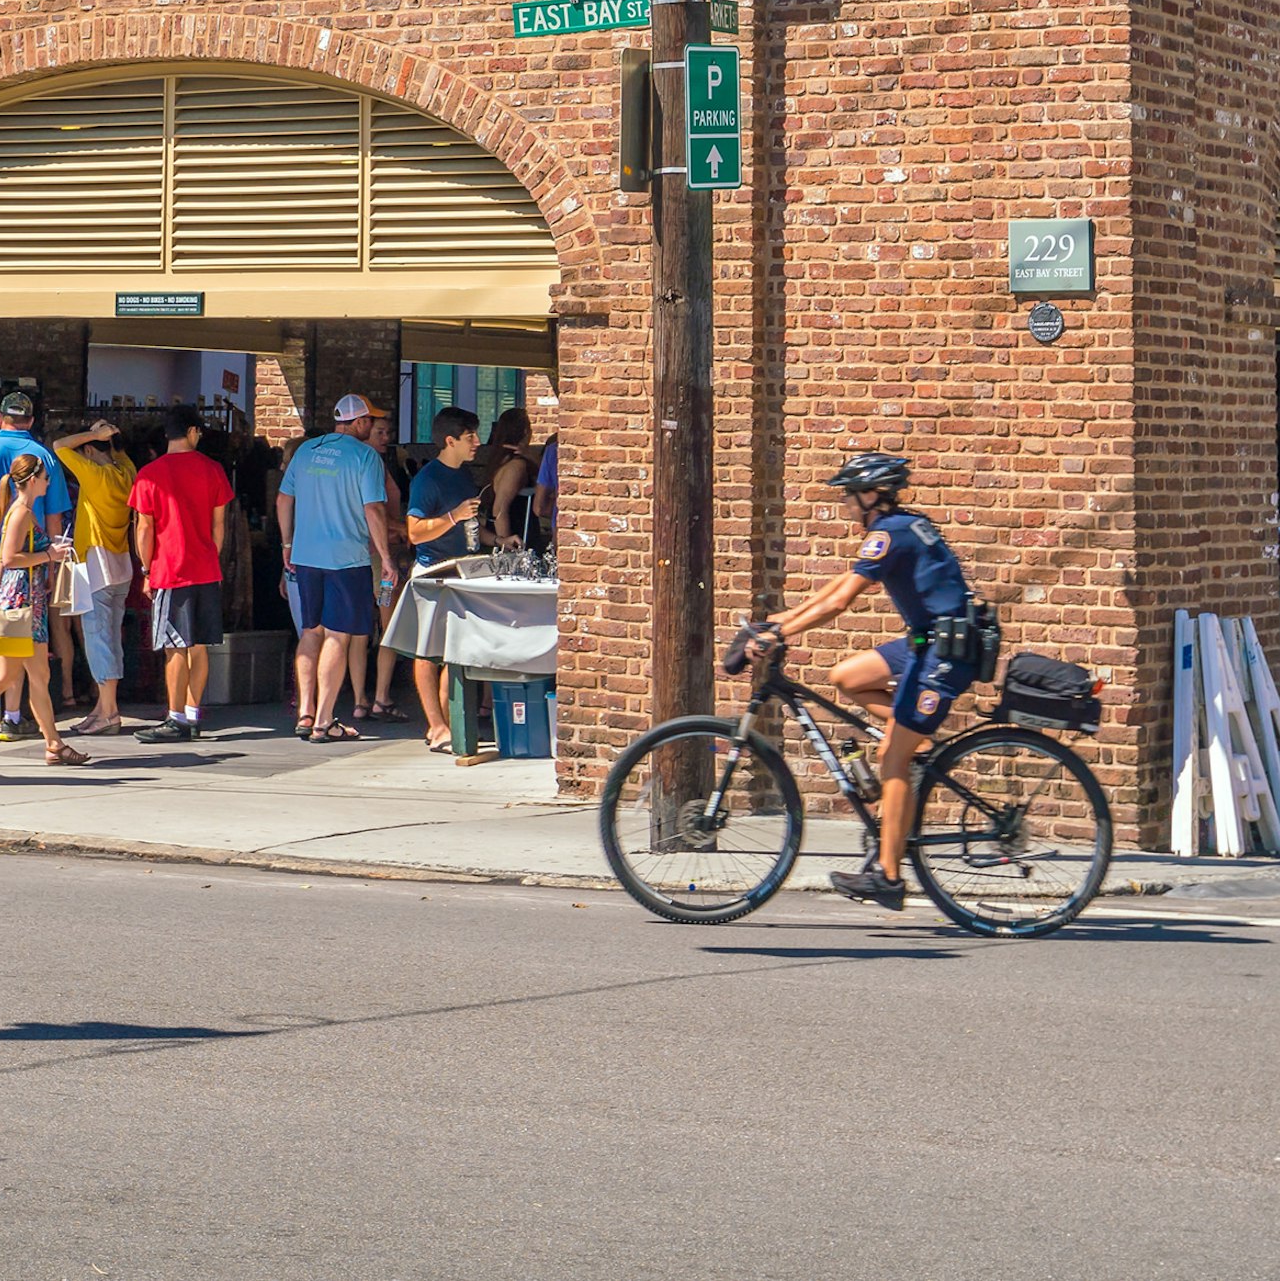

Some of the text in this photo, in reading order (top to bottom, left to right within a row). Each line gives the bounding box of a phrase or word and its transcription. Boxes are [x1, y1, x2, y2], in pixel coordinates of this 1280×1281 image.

[518, 3, 572, 33] EAST
[627, 0, 643, 18] ST
[710, 1, 732, 29] ARKET
[707, 64, 723, 100] P
[693, 109, 736, 127] PARKING
[1023, 233, 1075, 264] 229
[1014, 266, 1085, 279] EAST BAY STREET
[118, 296, 198, 304] NO DOGS NO BIKES NO SMOKING
